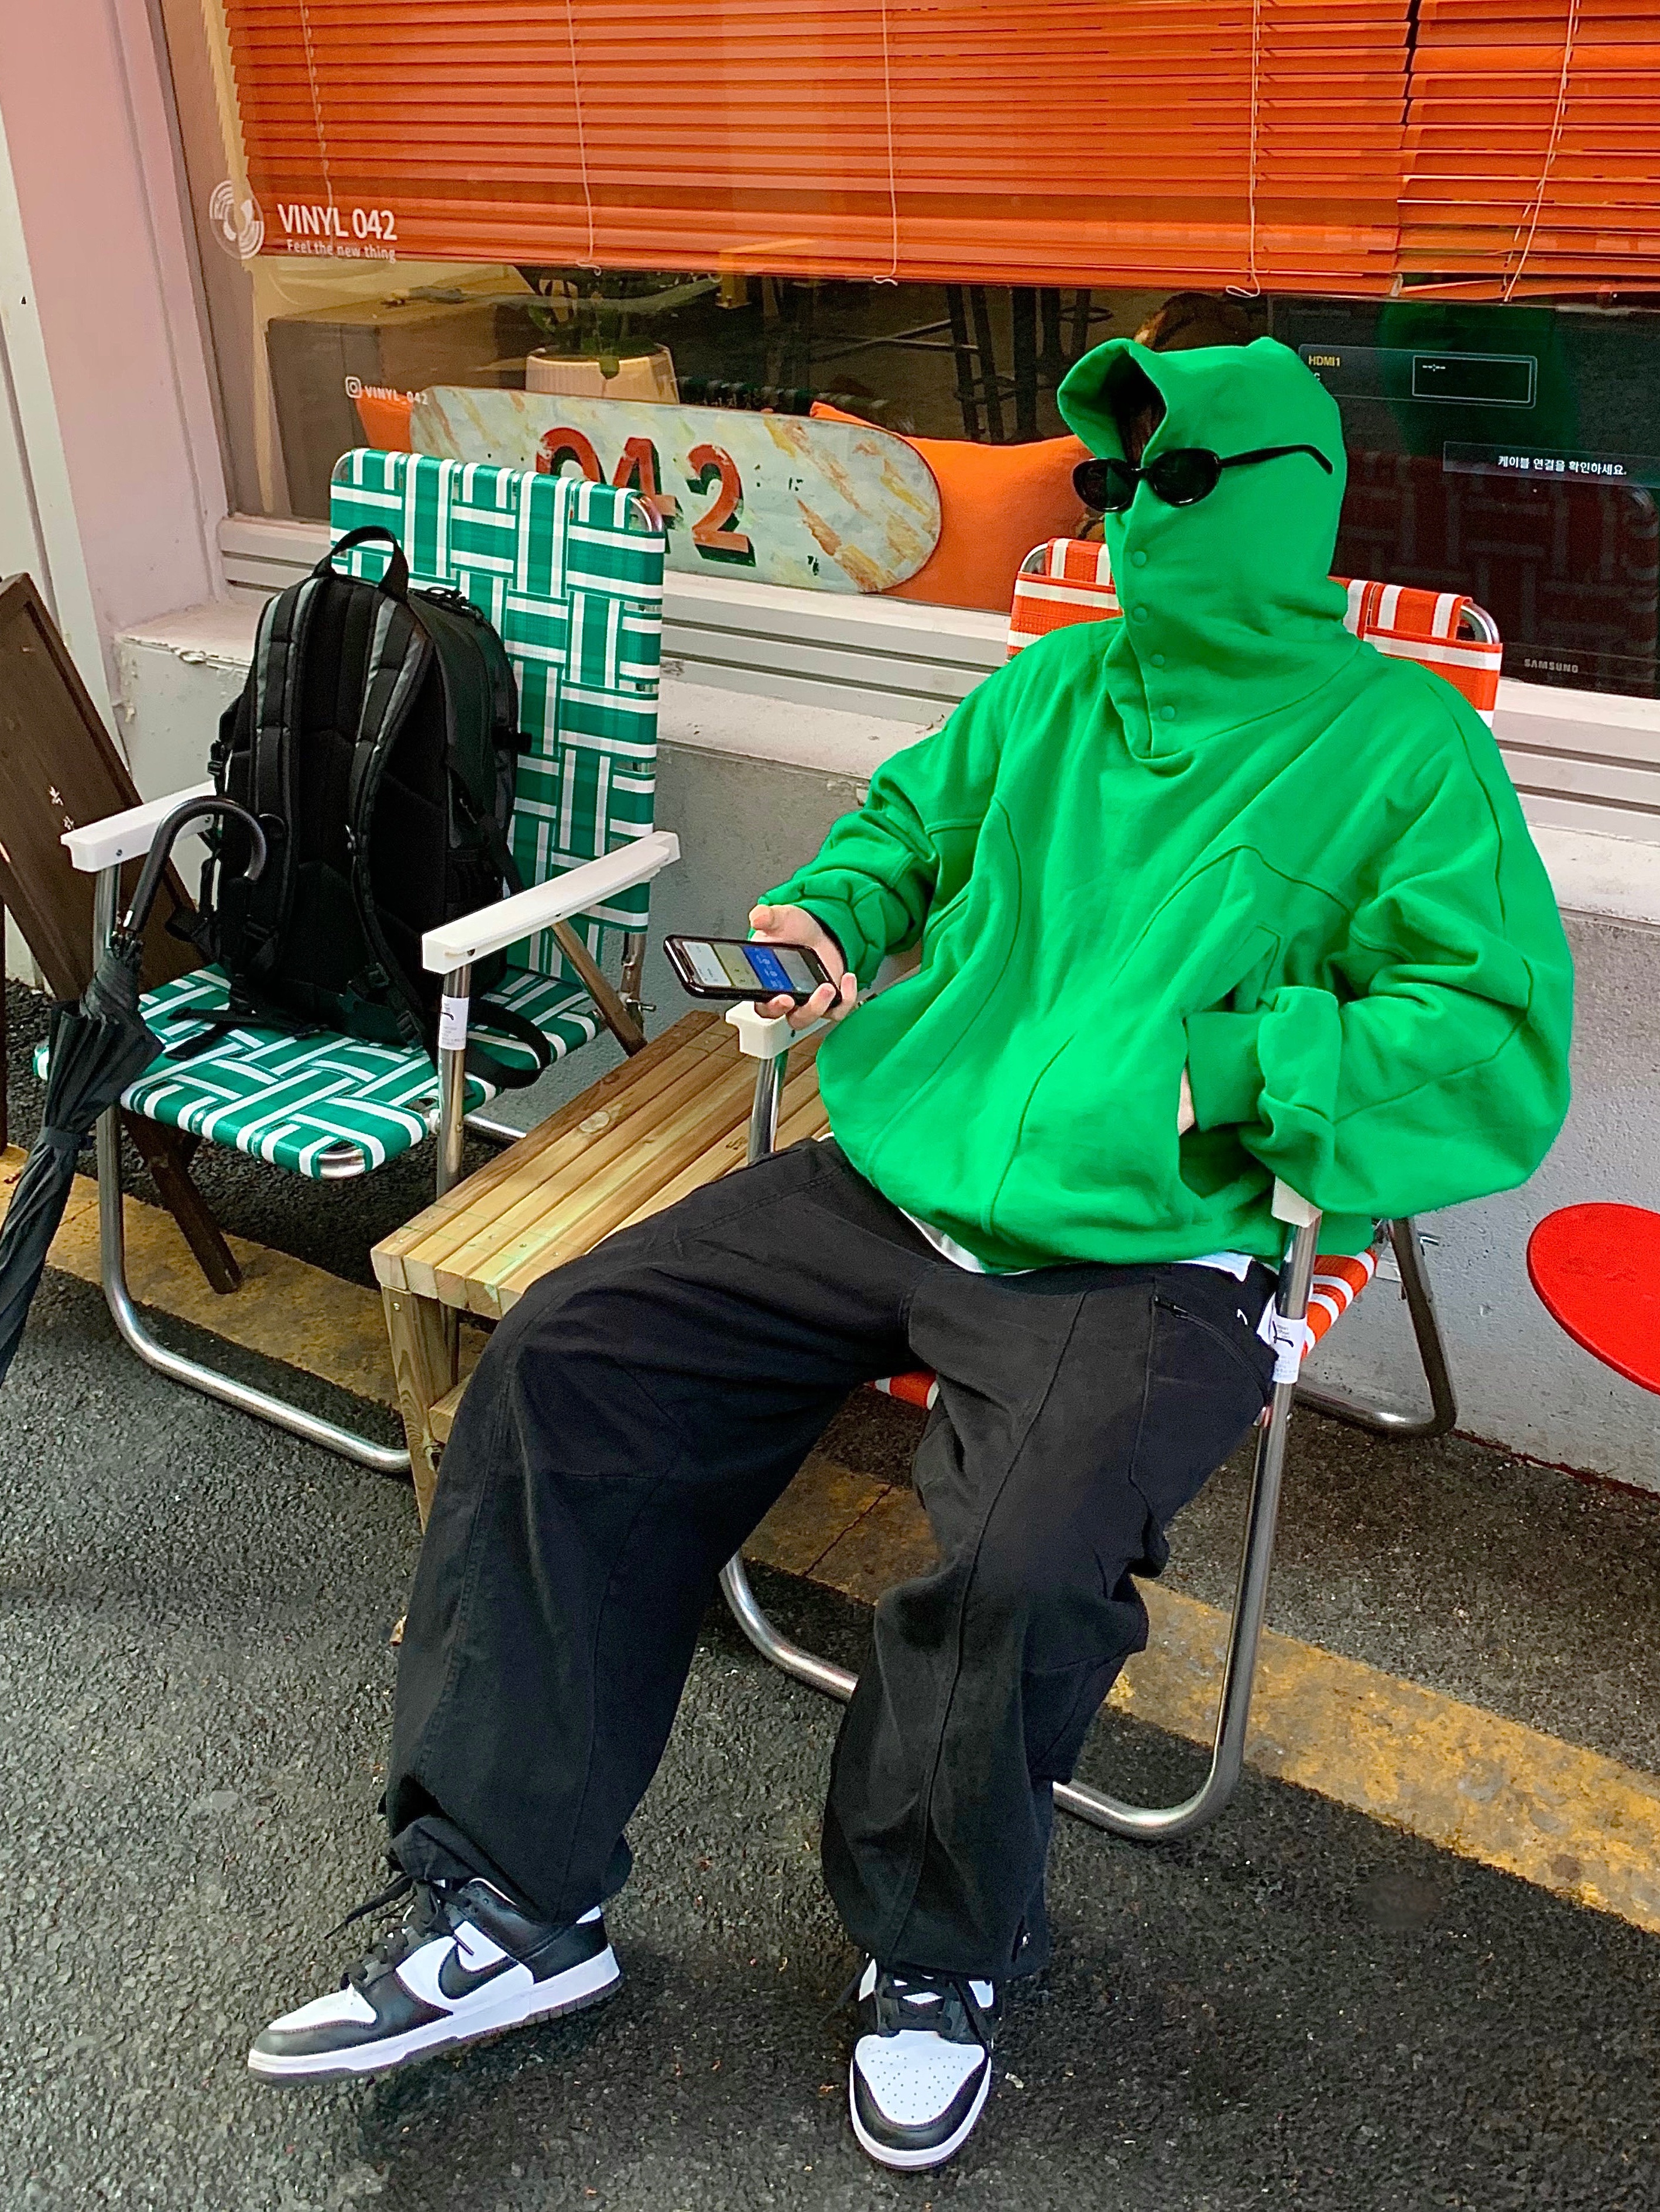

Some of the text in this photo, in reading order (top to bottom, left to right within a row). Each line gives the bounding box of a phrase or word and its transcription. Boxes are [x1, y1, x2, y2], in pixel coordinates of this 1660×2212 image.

[277, 203, 397, 241] VINYL 042
[286, 239, 396, 264] Feel the new thing
[1308, 355, 1340, 367] HDMI1
[1498, 456, 1627, 475] 케이블 연결을 확인하세요.
[1524, 658, 1579, 674] SAMSUNG
